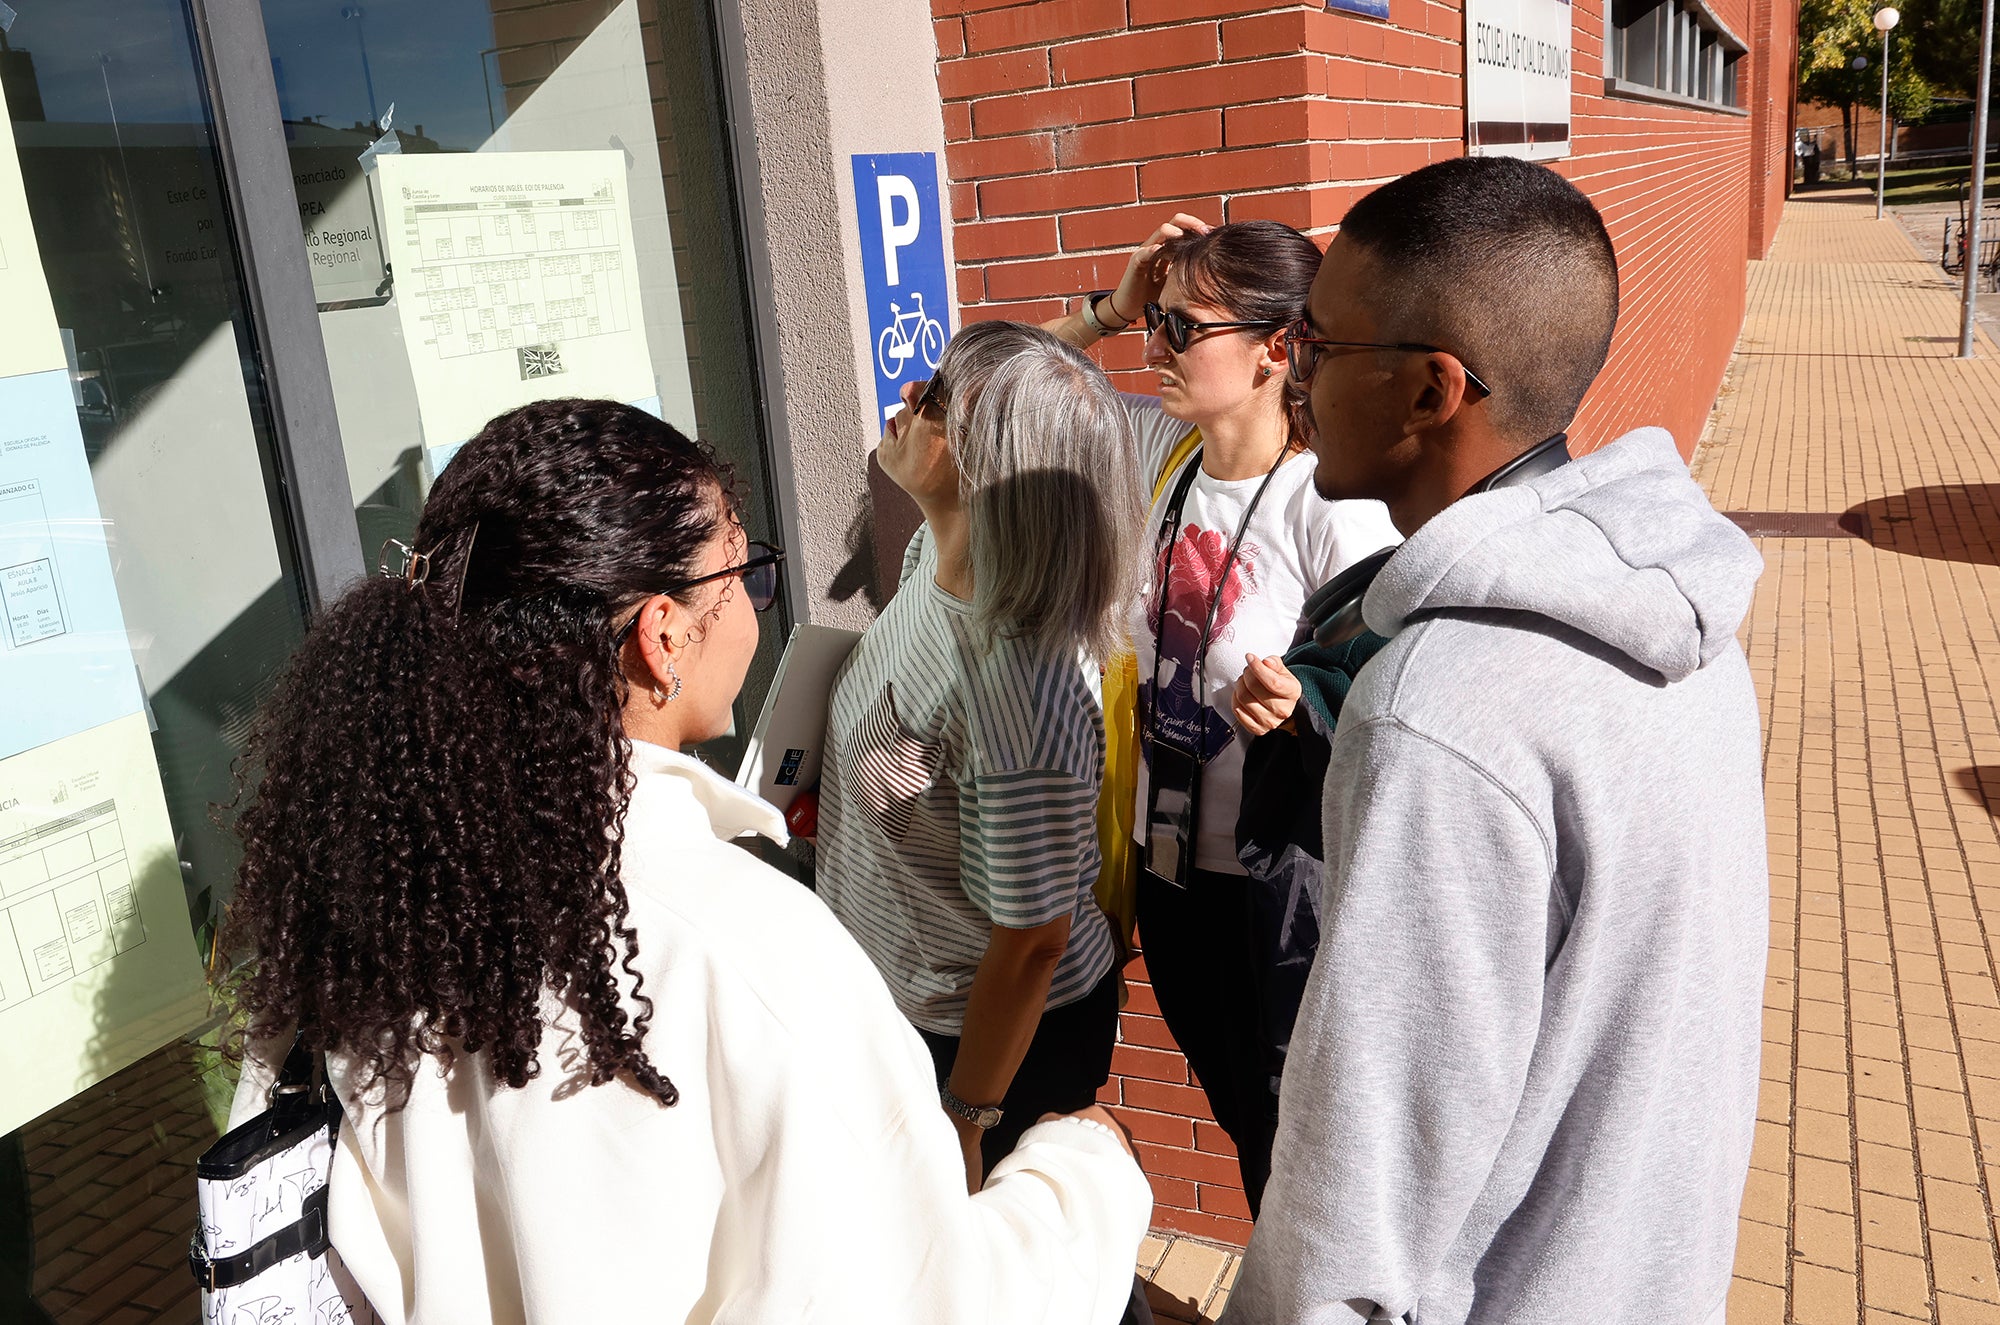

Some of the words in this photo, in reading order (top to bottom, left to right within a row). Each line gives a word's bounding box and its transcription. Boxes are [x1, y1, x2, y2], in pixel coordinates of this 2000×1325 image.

[1477, 22, 1511, 69] ESCUELA
[1537, 40, 1546, 76] DE
[470, 184, 497, 193] HORARIOS
[497, 184, 505, 192] DE
[541, 182, 565, 191] PALENCIA
[167, 189, 190, 204] Este
[323, 225, 372, 248] Regional
[877, 174, 921, 287] P
[166, 248, 198, 264] Fondo
[17, 577, 34, 587] AULA
[12, 614, 29, 622] Horas
[1186, 721, 1210, 734] dreas
